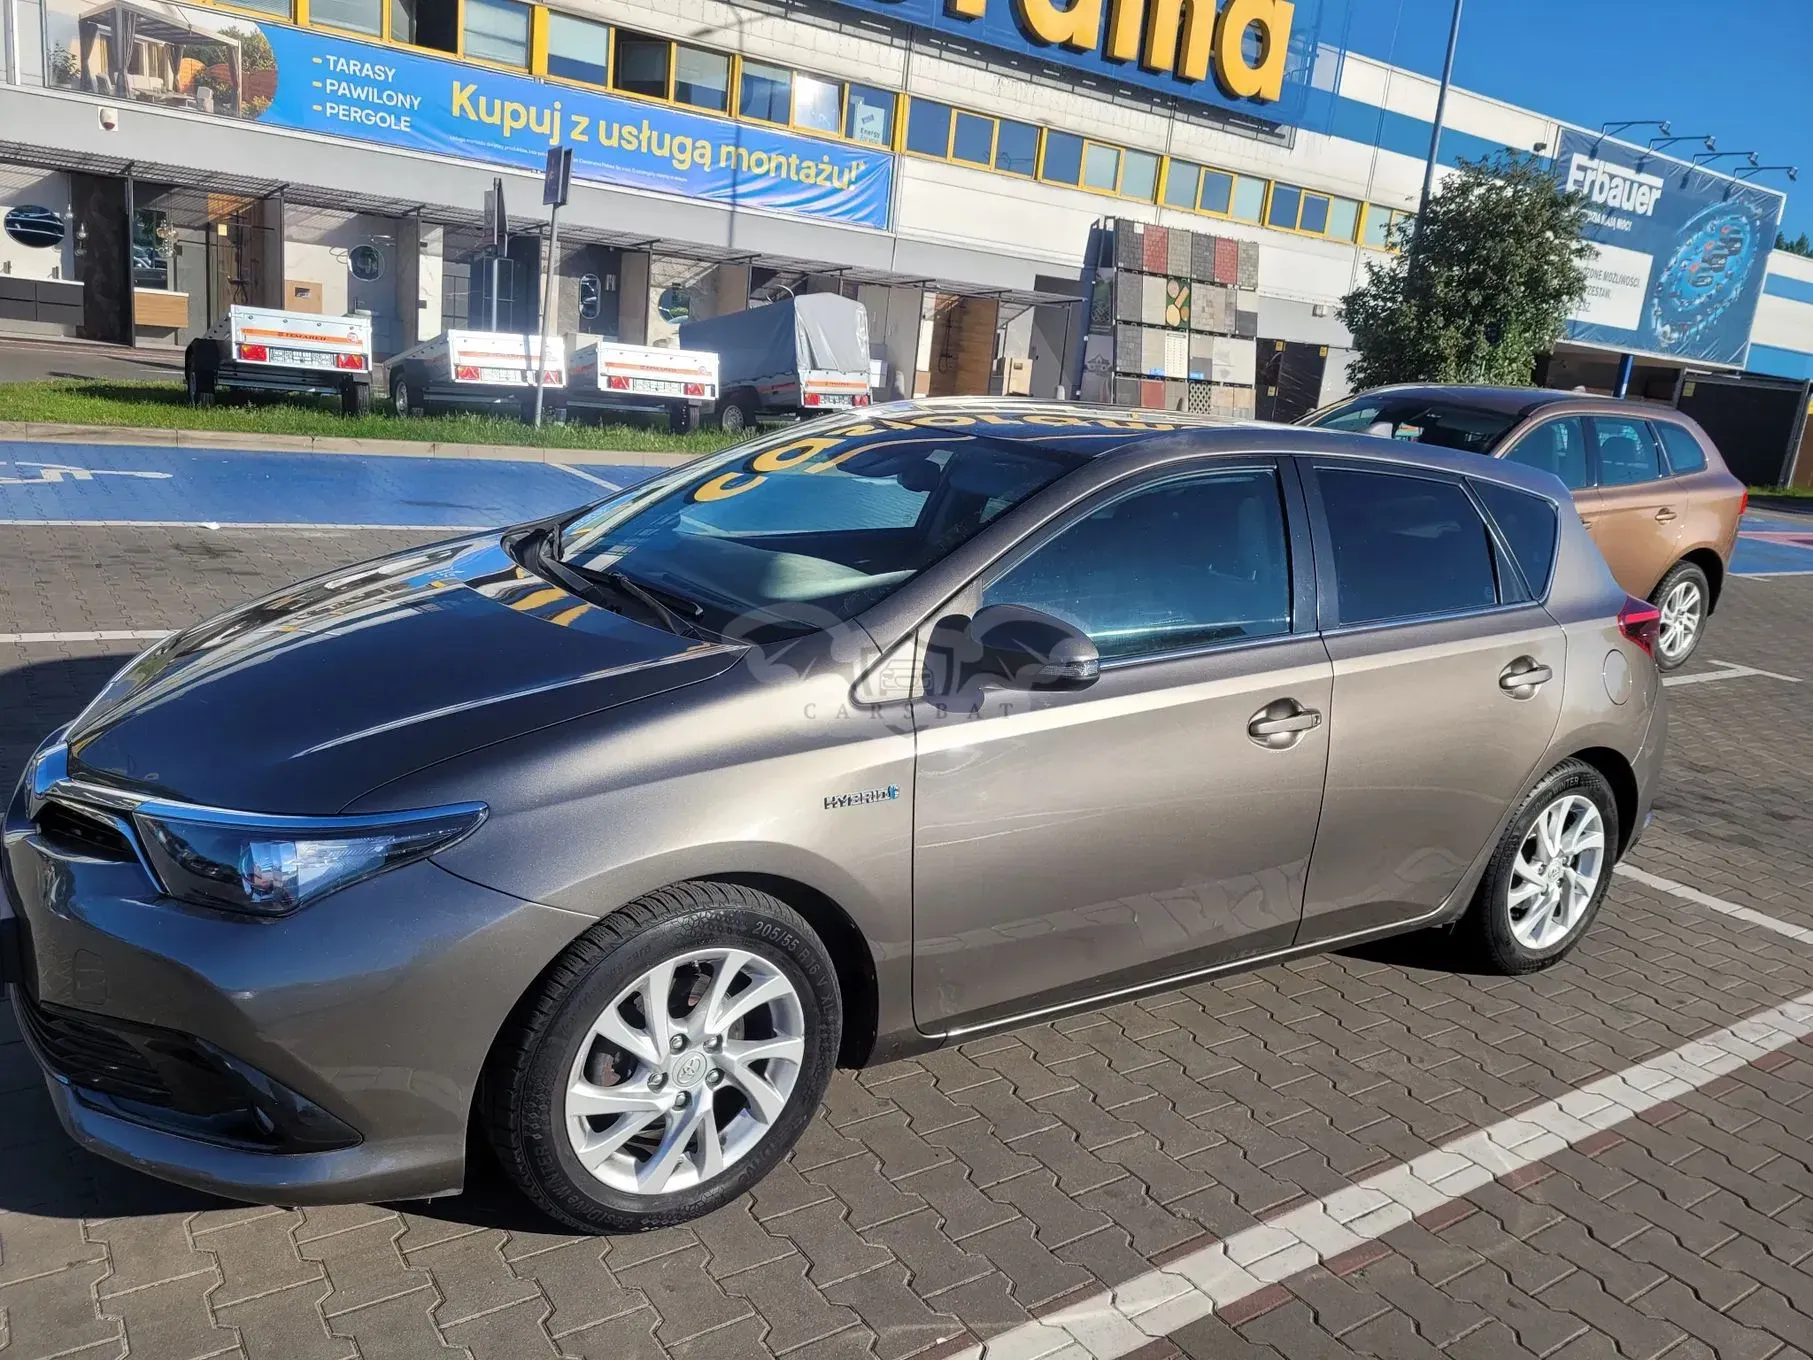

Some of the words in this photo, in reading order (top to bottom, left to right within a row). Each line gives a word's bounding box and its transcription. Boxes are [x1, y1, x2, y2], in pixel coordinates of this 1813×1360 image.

[326, 55, 396, 83] TARASY
[326, 79, 422, 110] PAWILONY
[326, 102, 412, 132] PERGOLE
[451, 80, 562, 145] Kupuj
[570, 114, 590, 142] z
[598, 120, 712, 173] usługą
[1566, 152, 1664, 217] Erbauer
[823, 789, 890, 809] HYBRID
[752, 921, 800, 952] 205/55
